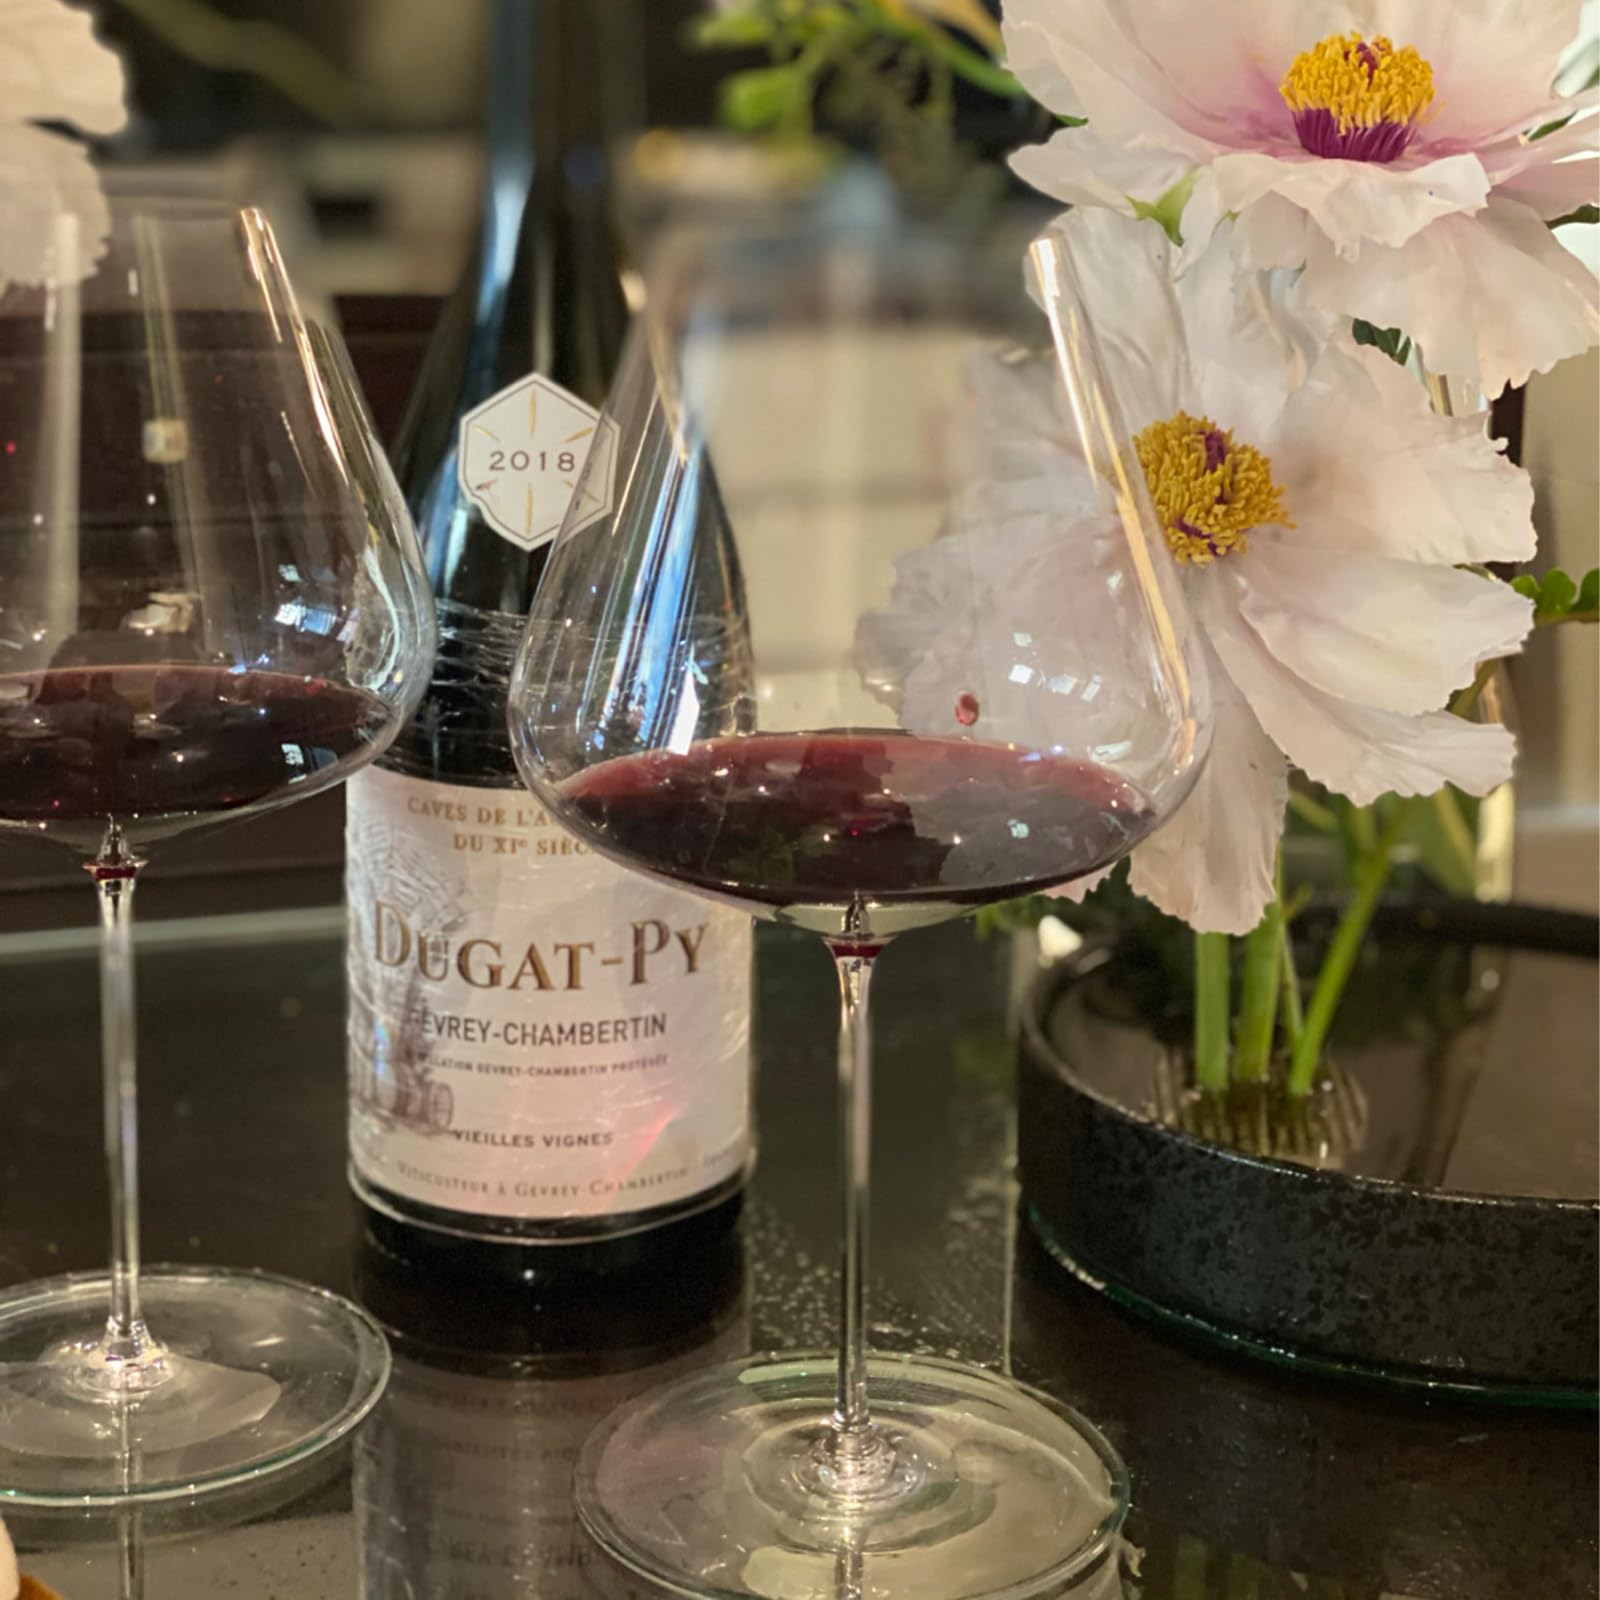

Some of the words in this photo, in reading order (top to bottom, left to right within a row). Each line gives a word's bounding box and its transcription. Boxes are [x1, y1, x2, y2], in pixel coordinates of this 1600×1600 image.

[488, 450, 576, 473] 2018
[407, 796, 467, 823] CAVES
[477, 807, 506, 826] DE
[453, 833, 484, 853] DU
[536, 834, 592, 856] SIÈC
[373, 900, 710, 992] DUGAT-PY
[452, 1129, 536, 1148] VIEILLES
[542, 1131, 614, 1148] VIGNES
